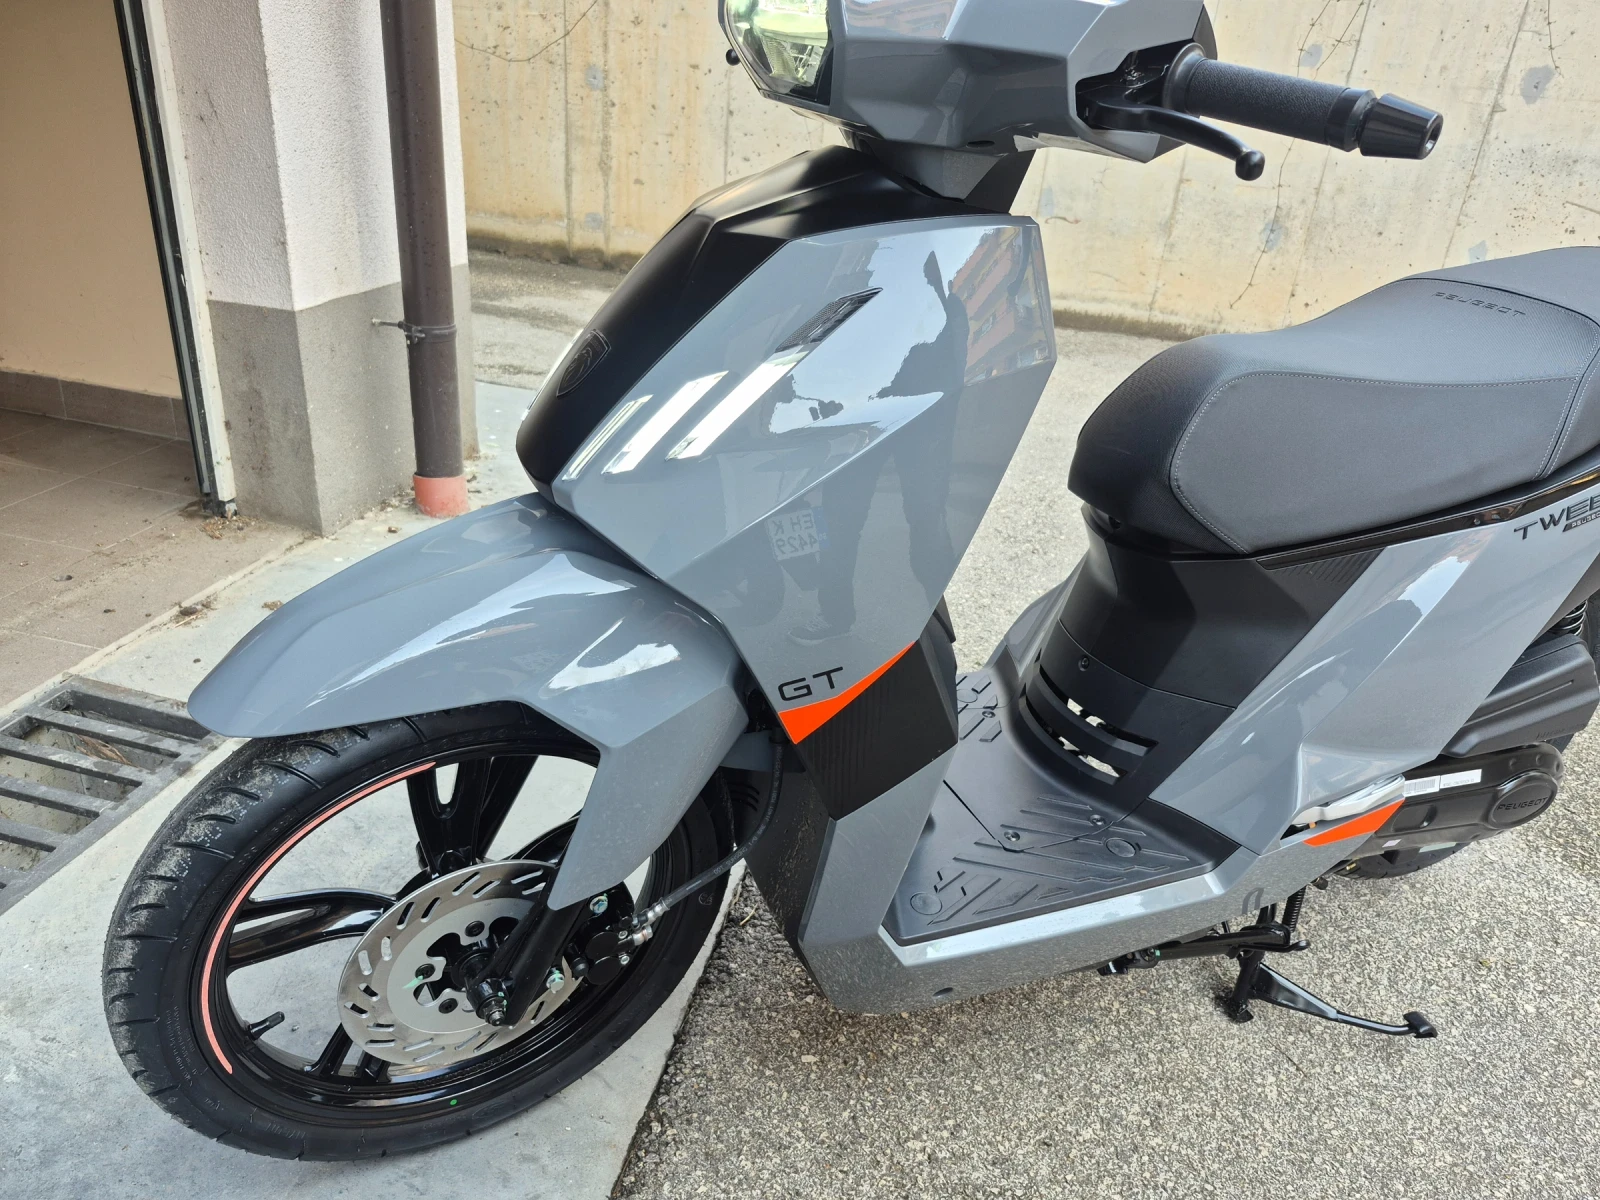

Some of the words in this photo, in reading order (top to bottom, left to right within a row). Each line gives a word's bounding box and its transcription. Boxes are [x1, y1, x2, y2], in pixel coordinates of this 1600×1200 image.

[1432, 291, 1526, 317] PEUGEOT
[778, 666, 844, 702] GT
[1496, 796, 1549, 811] PEUGEOT
